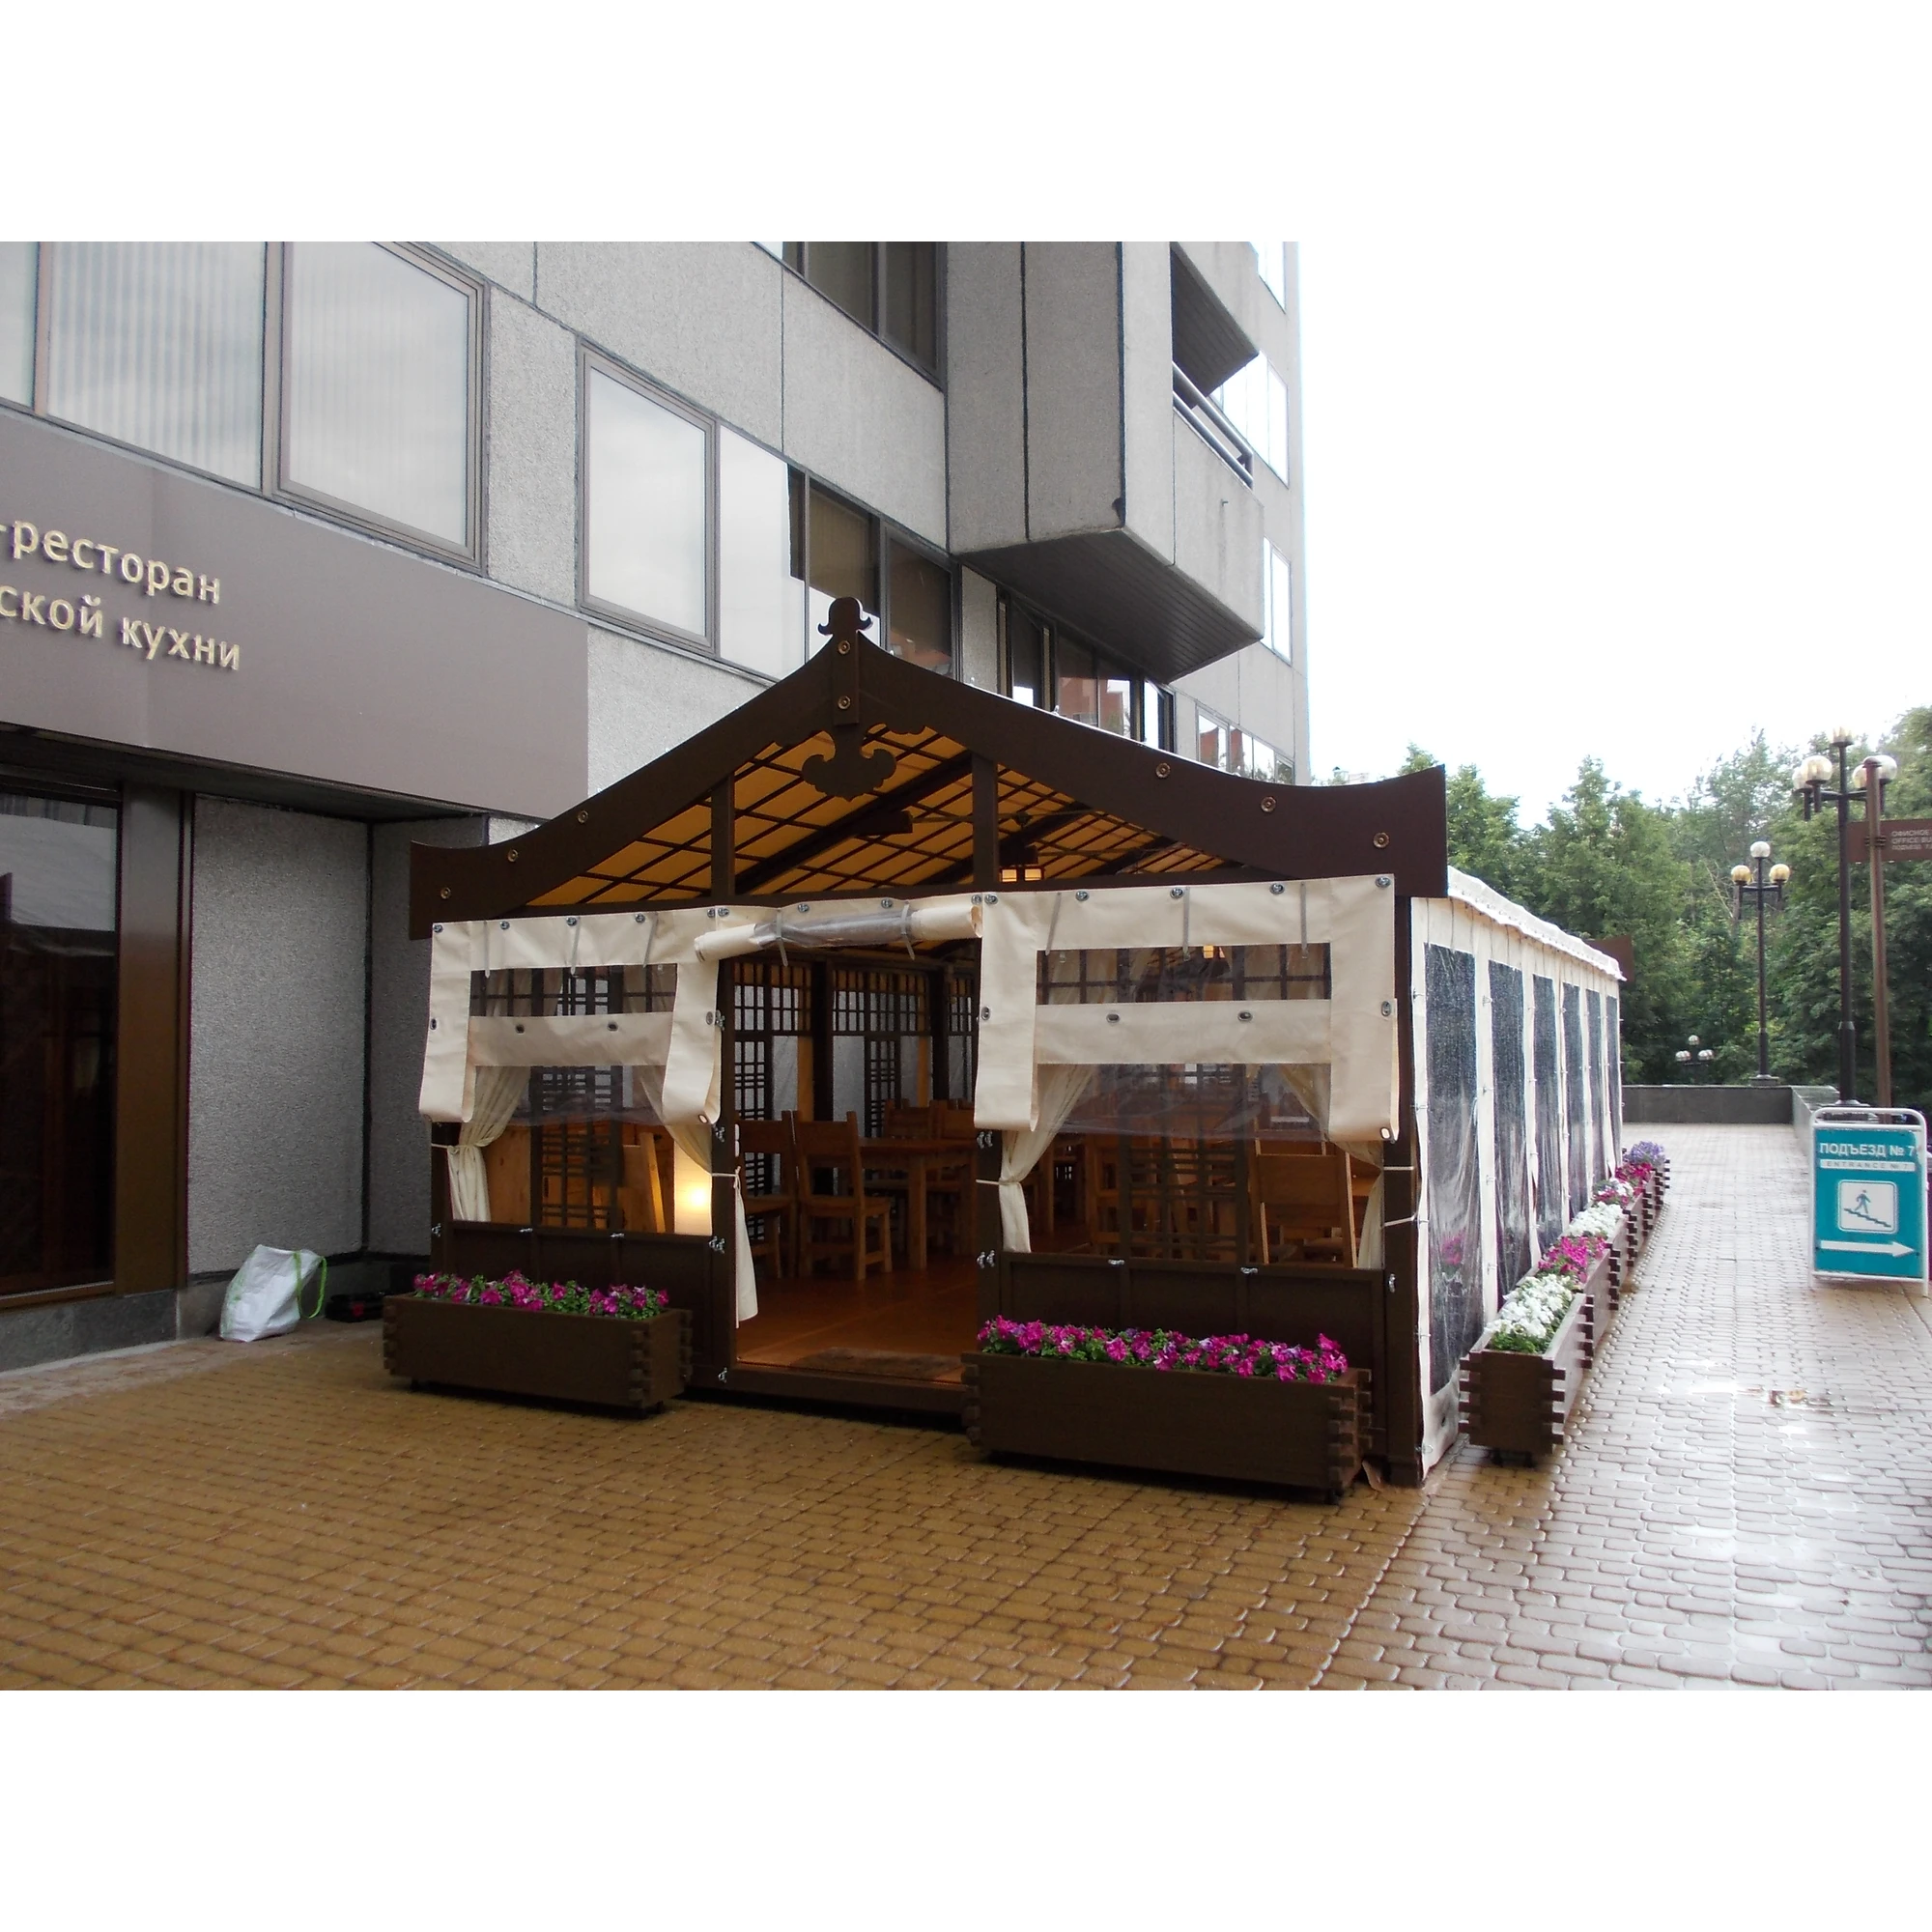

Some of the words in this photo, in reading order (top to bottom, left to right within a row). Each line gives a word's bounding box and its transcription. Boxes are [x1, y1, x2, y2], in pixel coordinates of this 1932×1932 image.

[121, 616, 240, 670] кухни
[1819, 1142, 1886, 1157] ПОДЪЕЗД
[1889, 1145, 1905, 1156] №
[1908, 1145, 1916, 1157] 7
[1827, 1160, 1886, 1169] ENTRANCE
